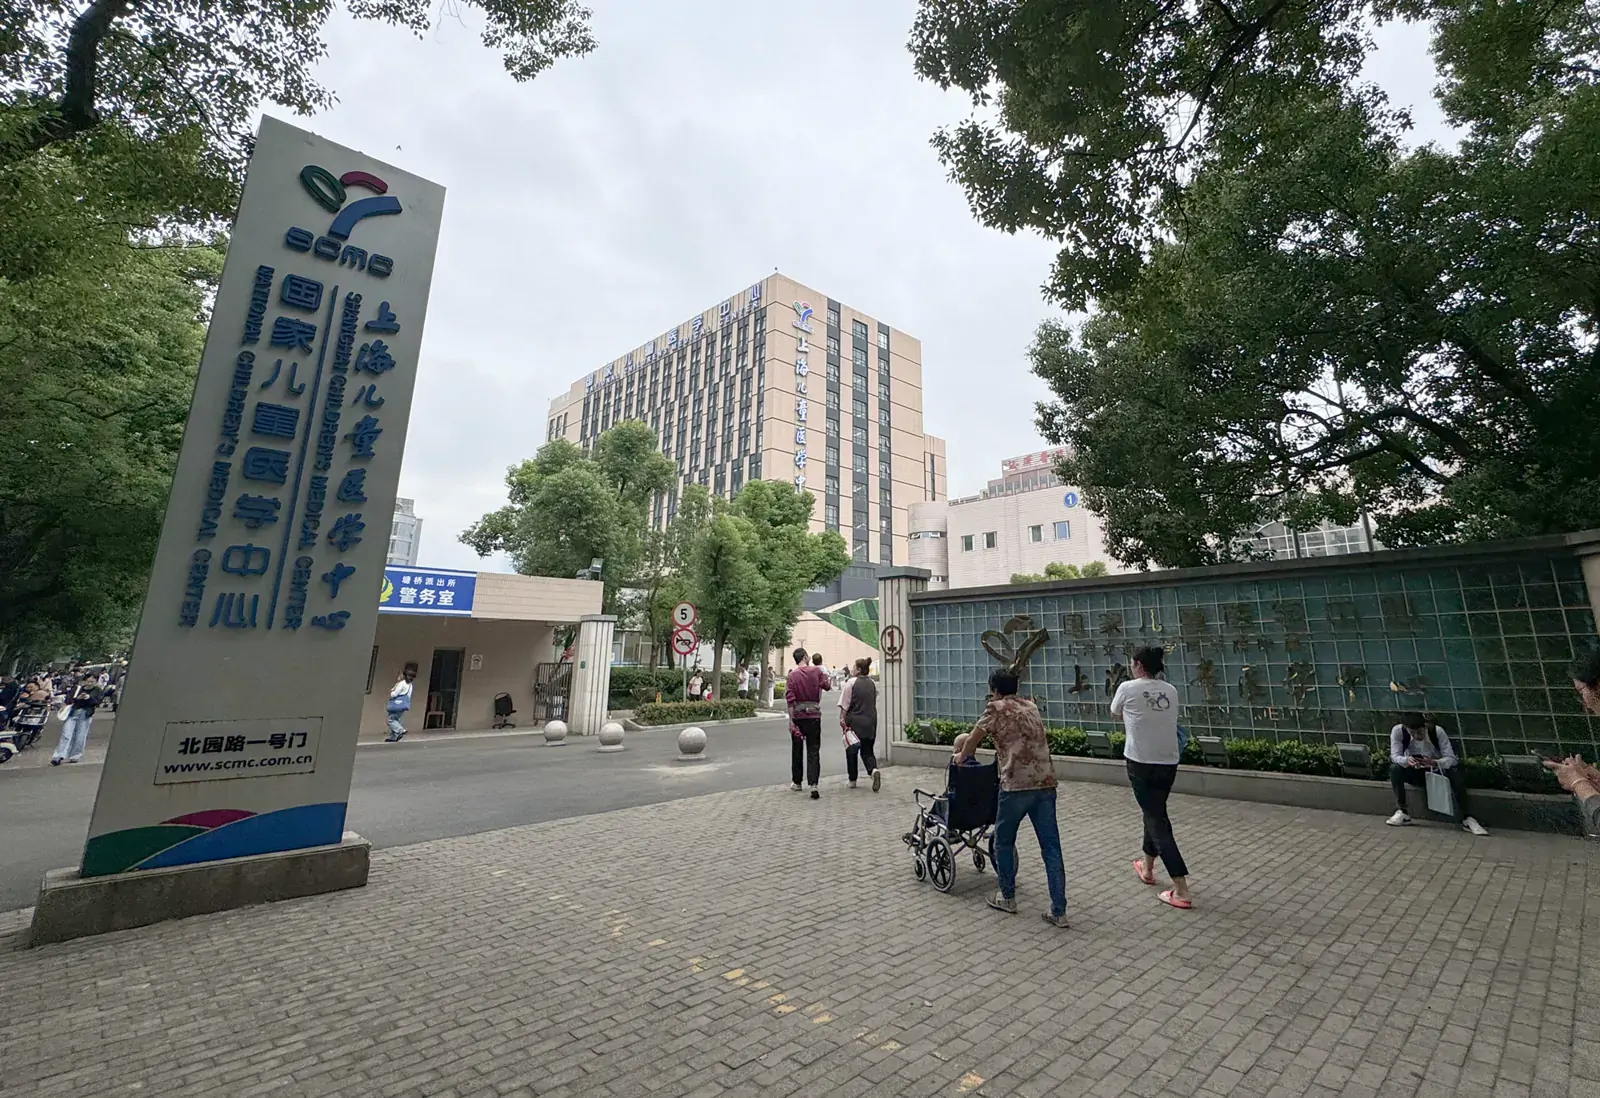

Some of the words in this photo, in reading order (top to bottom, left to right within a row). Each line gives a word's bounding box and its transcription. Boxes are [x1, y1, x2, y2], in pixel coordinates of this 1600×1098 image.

[243, 265, 275, 345] NATIONAL
[331, 291, 363, 374] SHANGHAI
[208, 273, 323, 628] 国家儿童医学中心
[311, 301, 400, 630] 上海儿童医学中心
[197, 461, 232, 542] MEDICAL
[299, 476, 329, 551] MEDICAL
[1067, 494, 1073, 505] 1
[179, 548, 213, 628] CENTER
[282, 556, 314, 630] CENTER
[399, 587, 455, 606] 警务室
[401, 576, 456, 587] 塘桥派出所
[680, 608, 687, 620] 5
[886, 630, 897, 651] 1
[164, 754, 313, 774] www.scmc.com.cn
[178, 732, 308, 755] 北园路一号门
